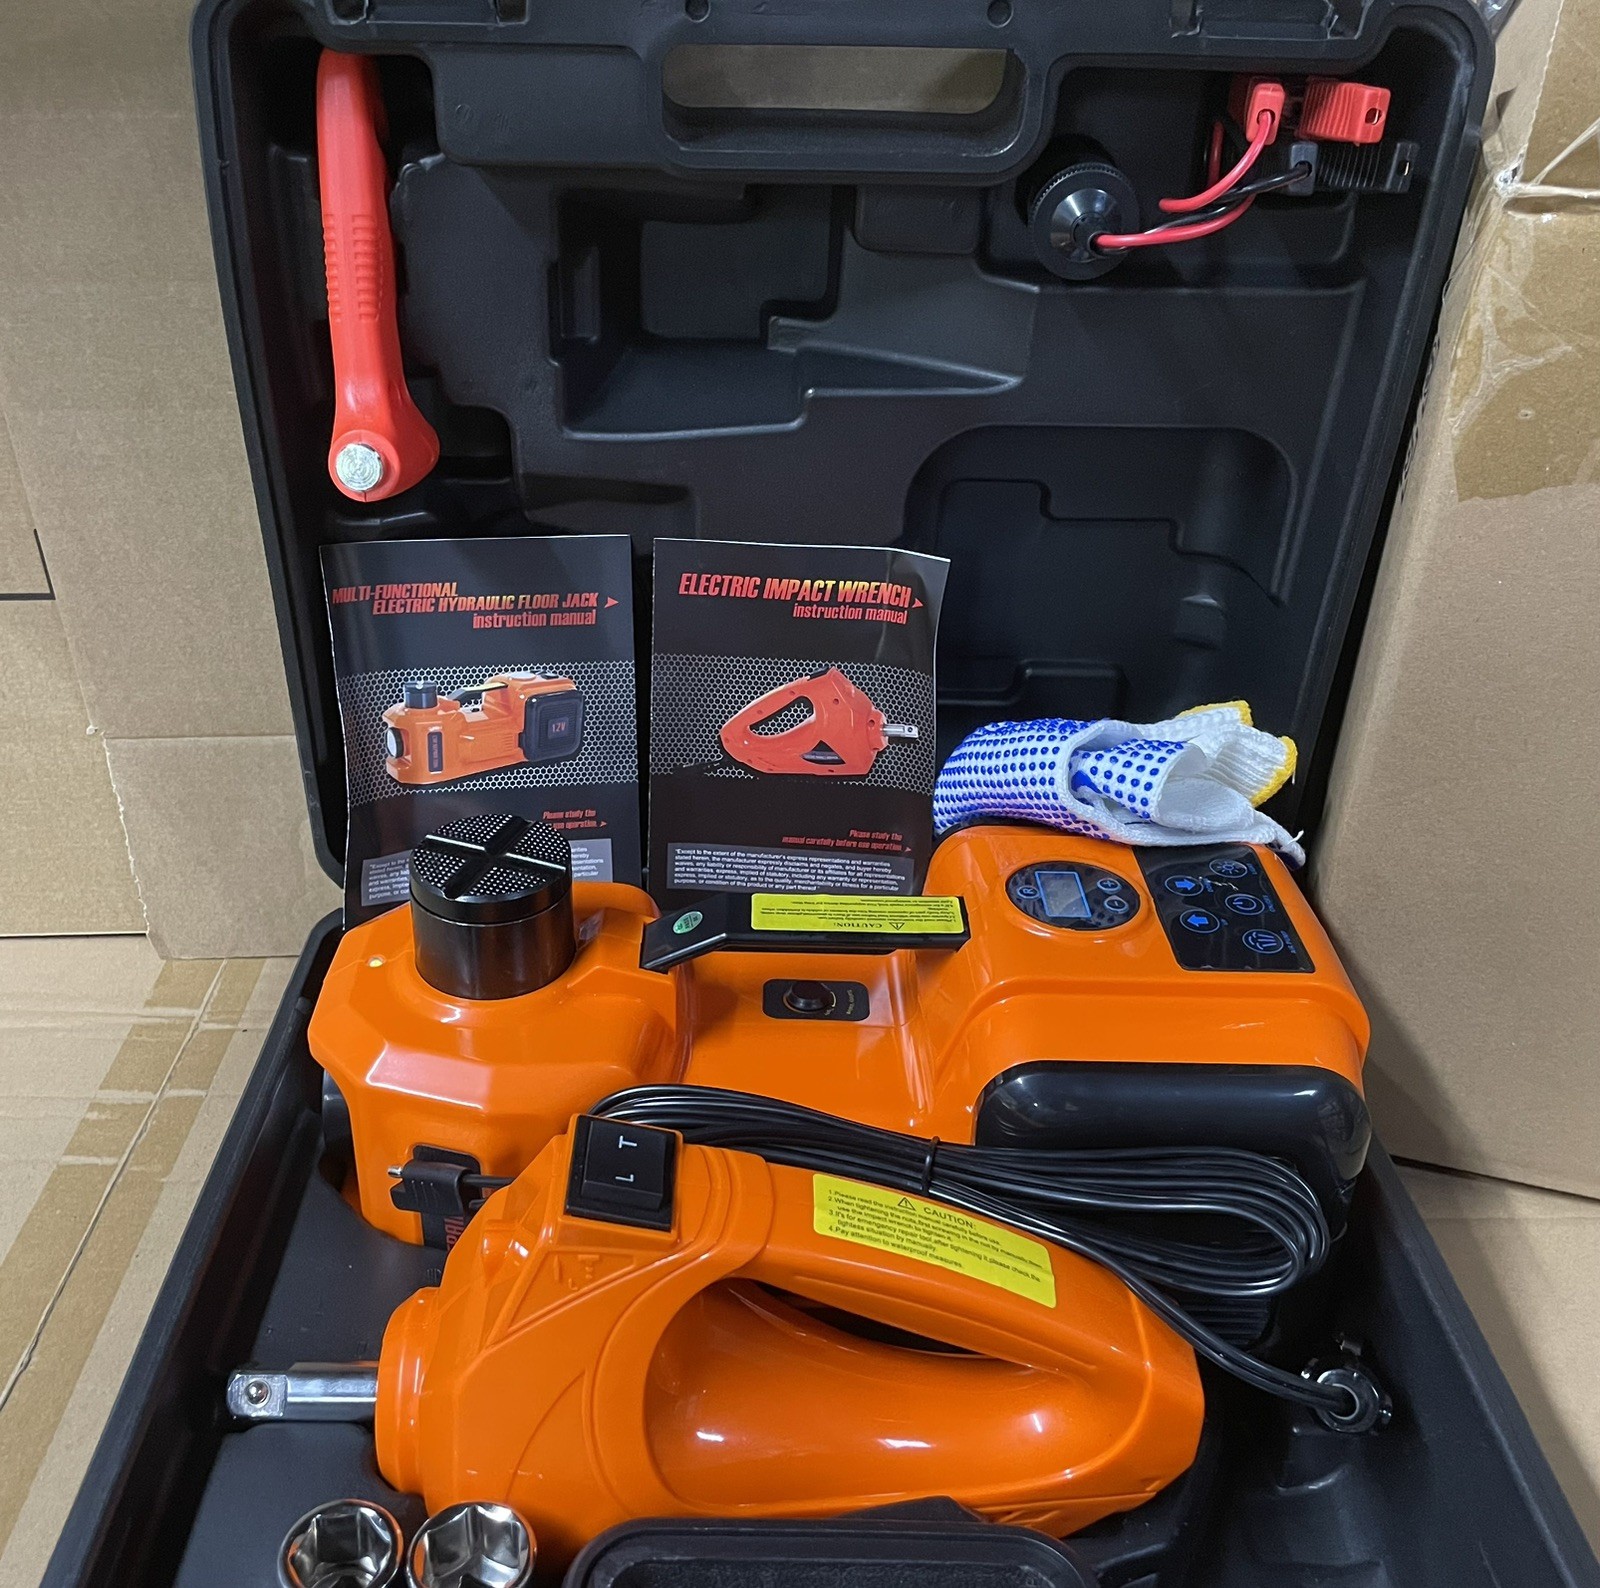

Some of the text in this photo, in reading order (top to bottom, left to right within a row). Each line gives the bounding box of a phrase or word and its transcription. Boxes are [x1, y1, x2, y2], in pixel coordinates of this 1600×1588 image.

[332, 582, 458, 604] MULTI-FUNCTIONAL
[679, 573, 912, 608] ELECTRIC IMPACT WRENCH
[373, 593, 599, 615] ELECTRIC HYDRAULIC FLOOR JACK
[793, 603, 907, 625] instruction manual
[473, 610, 596, 629] instruction manual
[619, 1135, 638, 1149] T
[616, 1174, 634, 1183] L
[924, 1206, 976, 1230] CAUTION:
